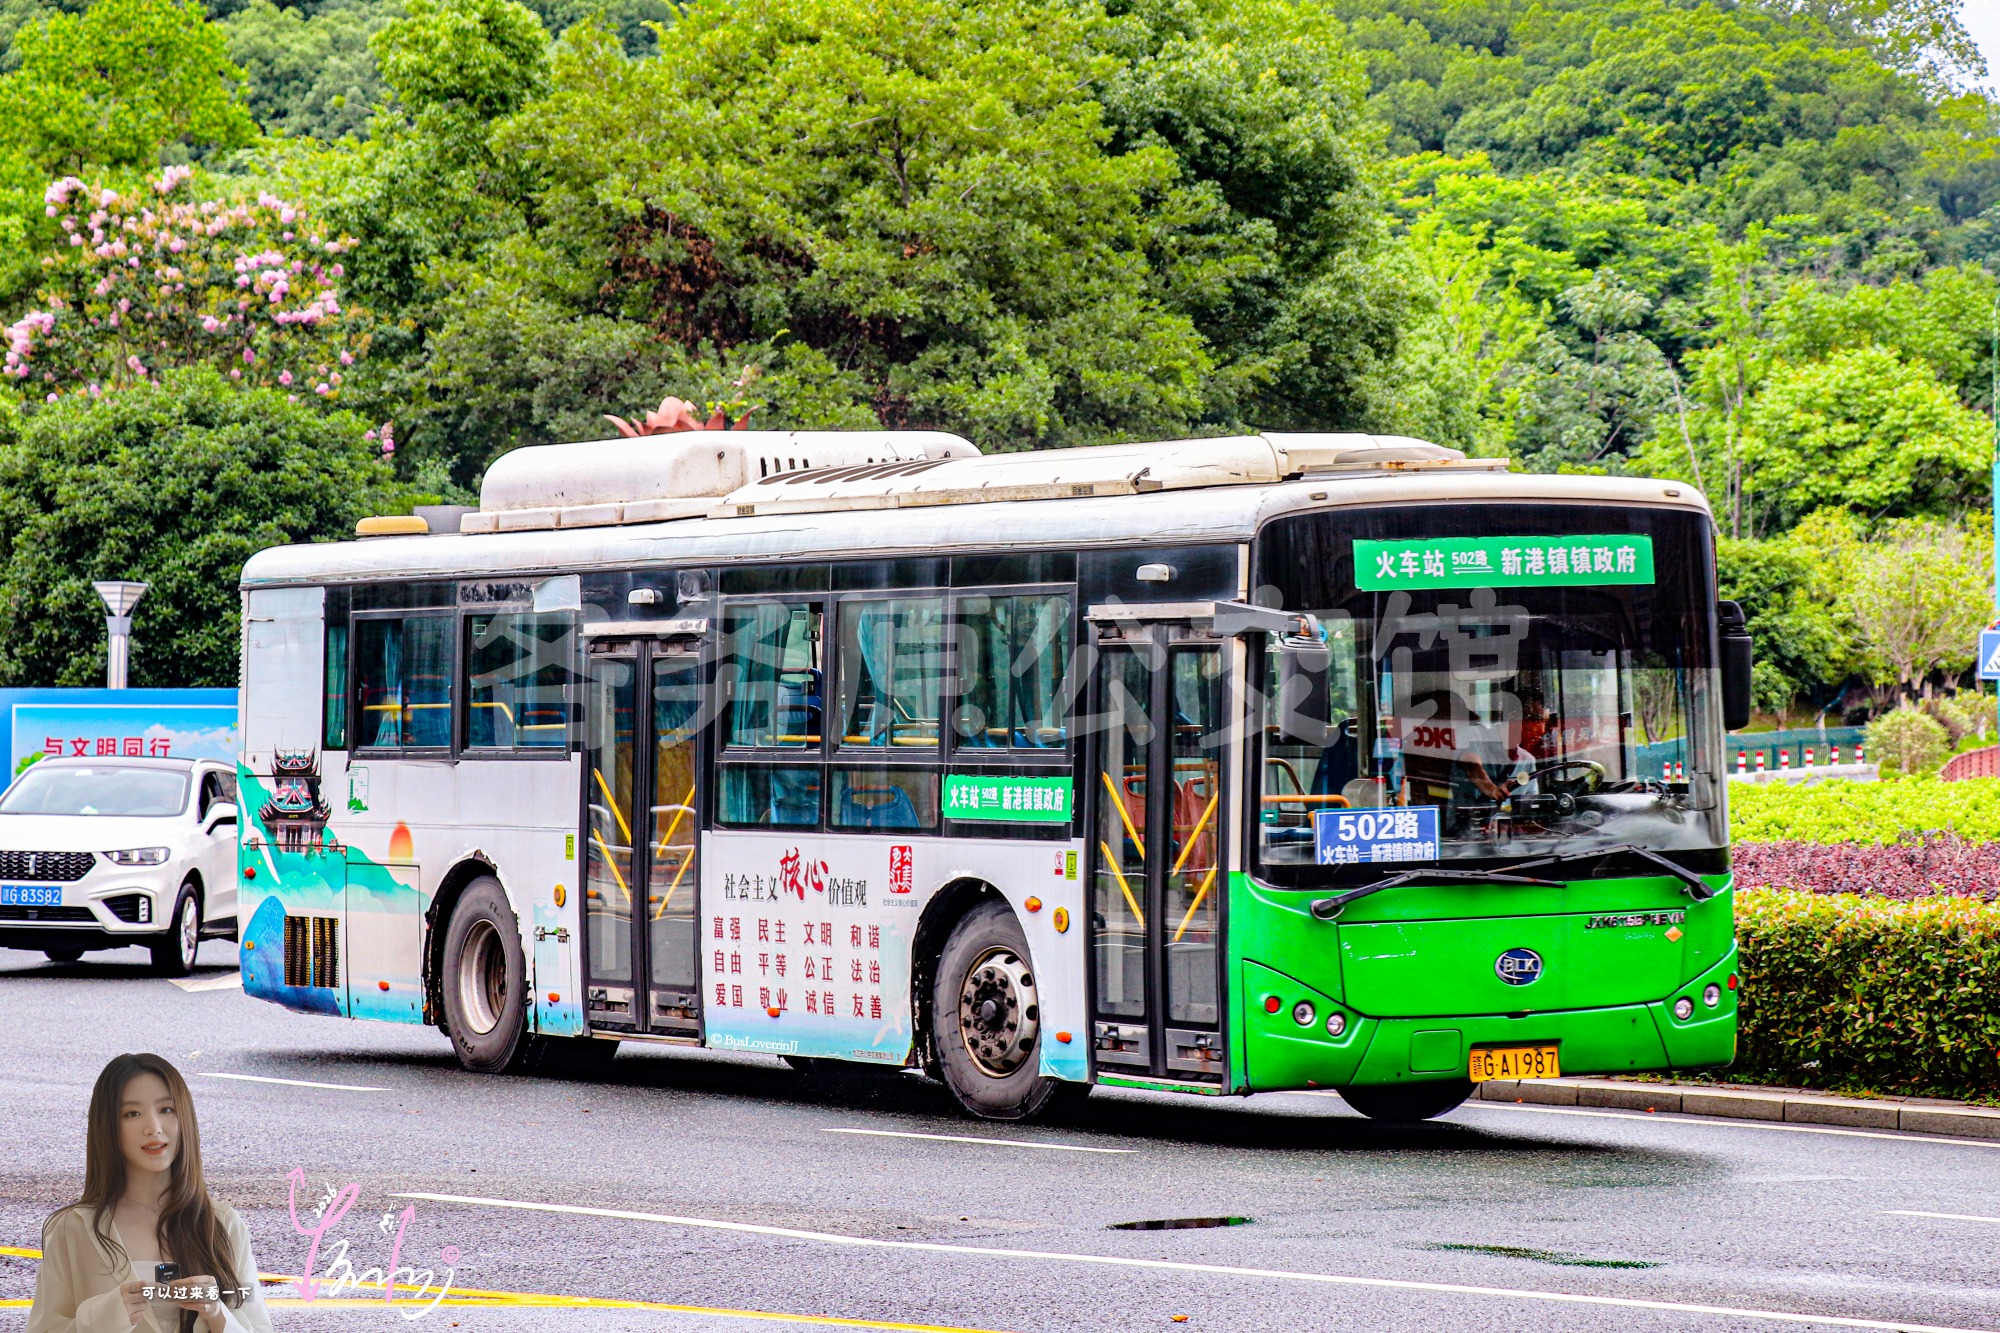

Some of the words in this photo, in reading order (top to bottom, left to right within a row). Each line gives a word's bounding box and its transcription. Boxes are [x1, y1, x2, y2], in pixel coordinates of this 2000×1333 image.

[1375, 550, 1445, 578] 火车站
[1451, 551, 1488, 566] 502路
[1500, 545, 1637, 576] 新港镇镇政府
[43, 737, 170, 757] 与文明同行
[949, 785, 979, 809] 火车站
[1002, 786, 1064, 812] 新港镇镇政府
[1338, 812, 1419, 841] 502路
[1322, 844, 1359, 865] 火车站
[725, 847, 867, 906] 社会主义核心价值观
[713, 915, 741, 940] 富强
[758, 918, 786, 943] 民主
[803, 921, 832, 947] 文明
[850, 924, 880, 949] 和谐
[714, 950, 742, 974] 自由
[758, 953, 787, 978] 平等
[804, 956, 833, 982] 公正
[851, 959, 881, 984] 法治
[715, 983, 743, 1007] 爱国
[759, 986, 788, 1011] 敬业
[805, 990, 835, 1016] 诚信
[852, 993, 882, 1020] 友善
